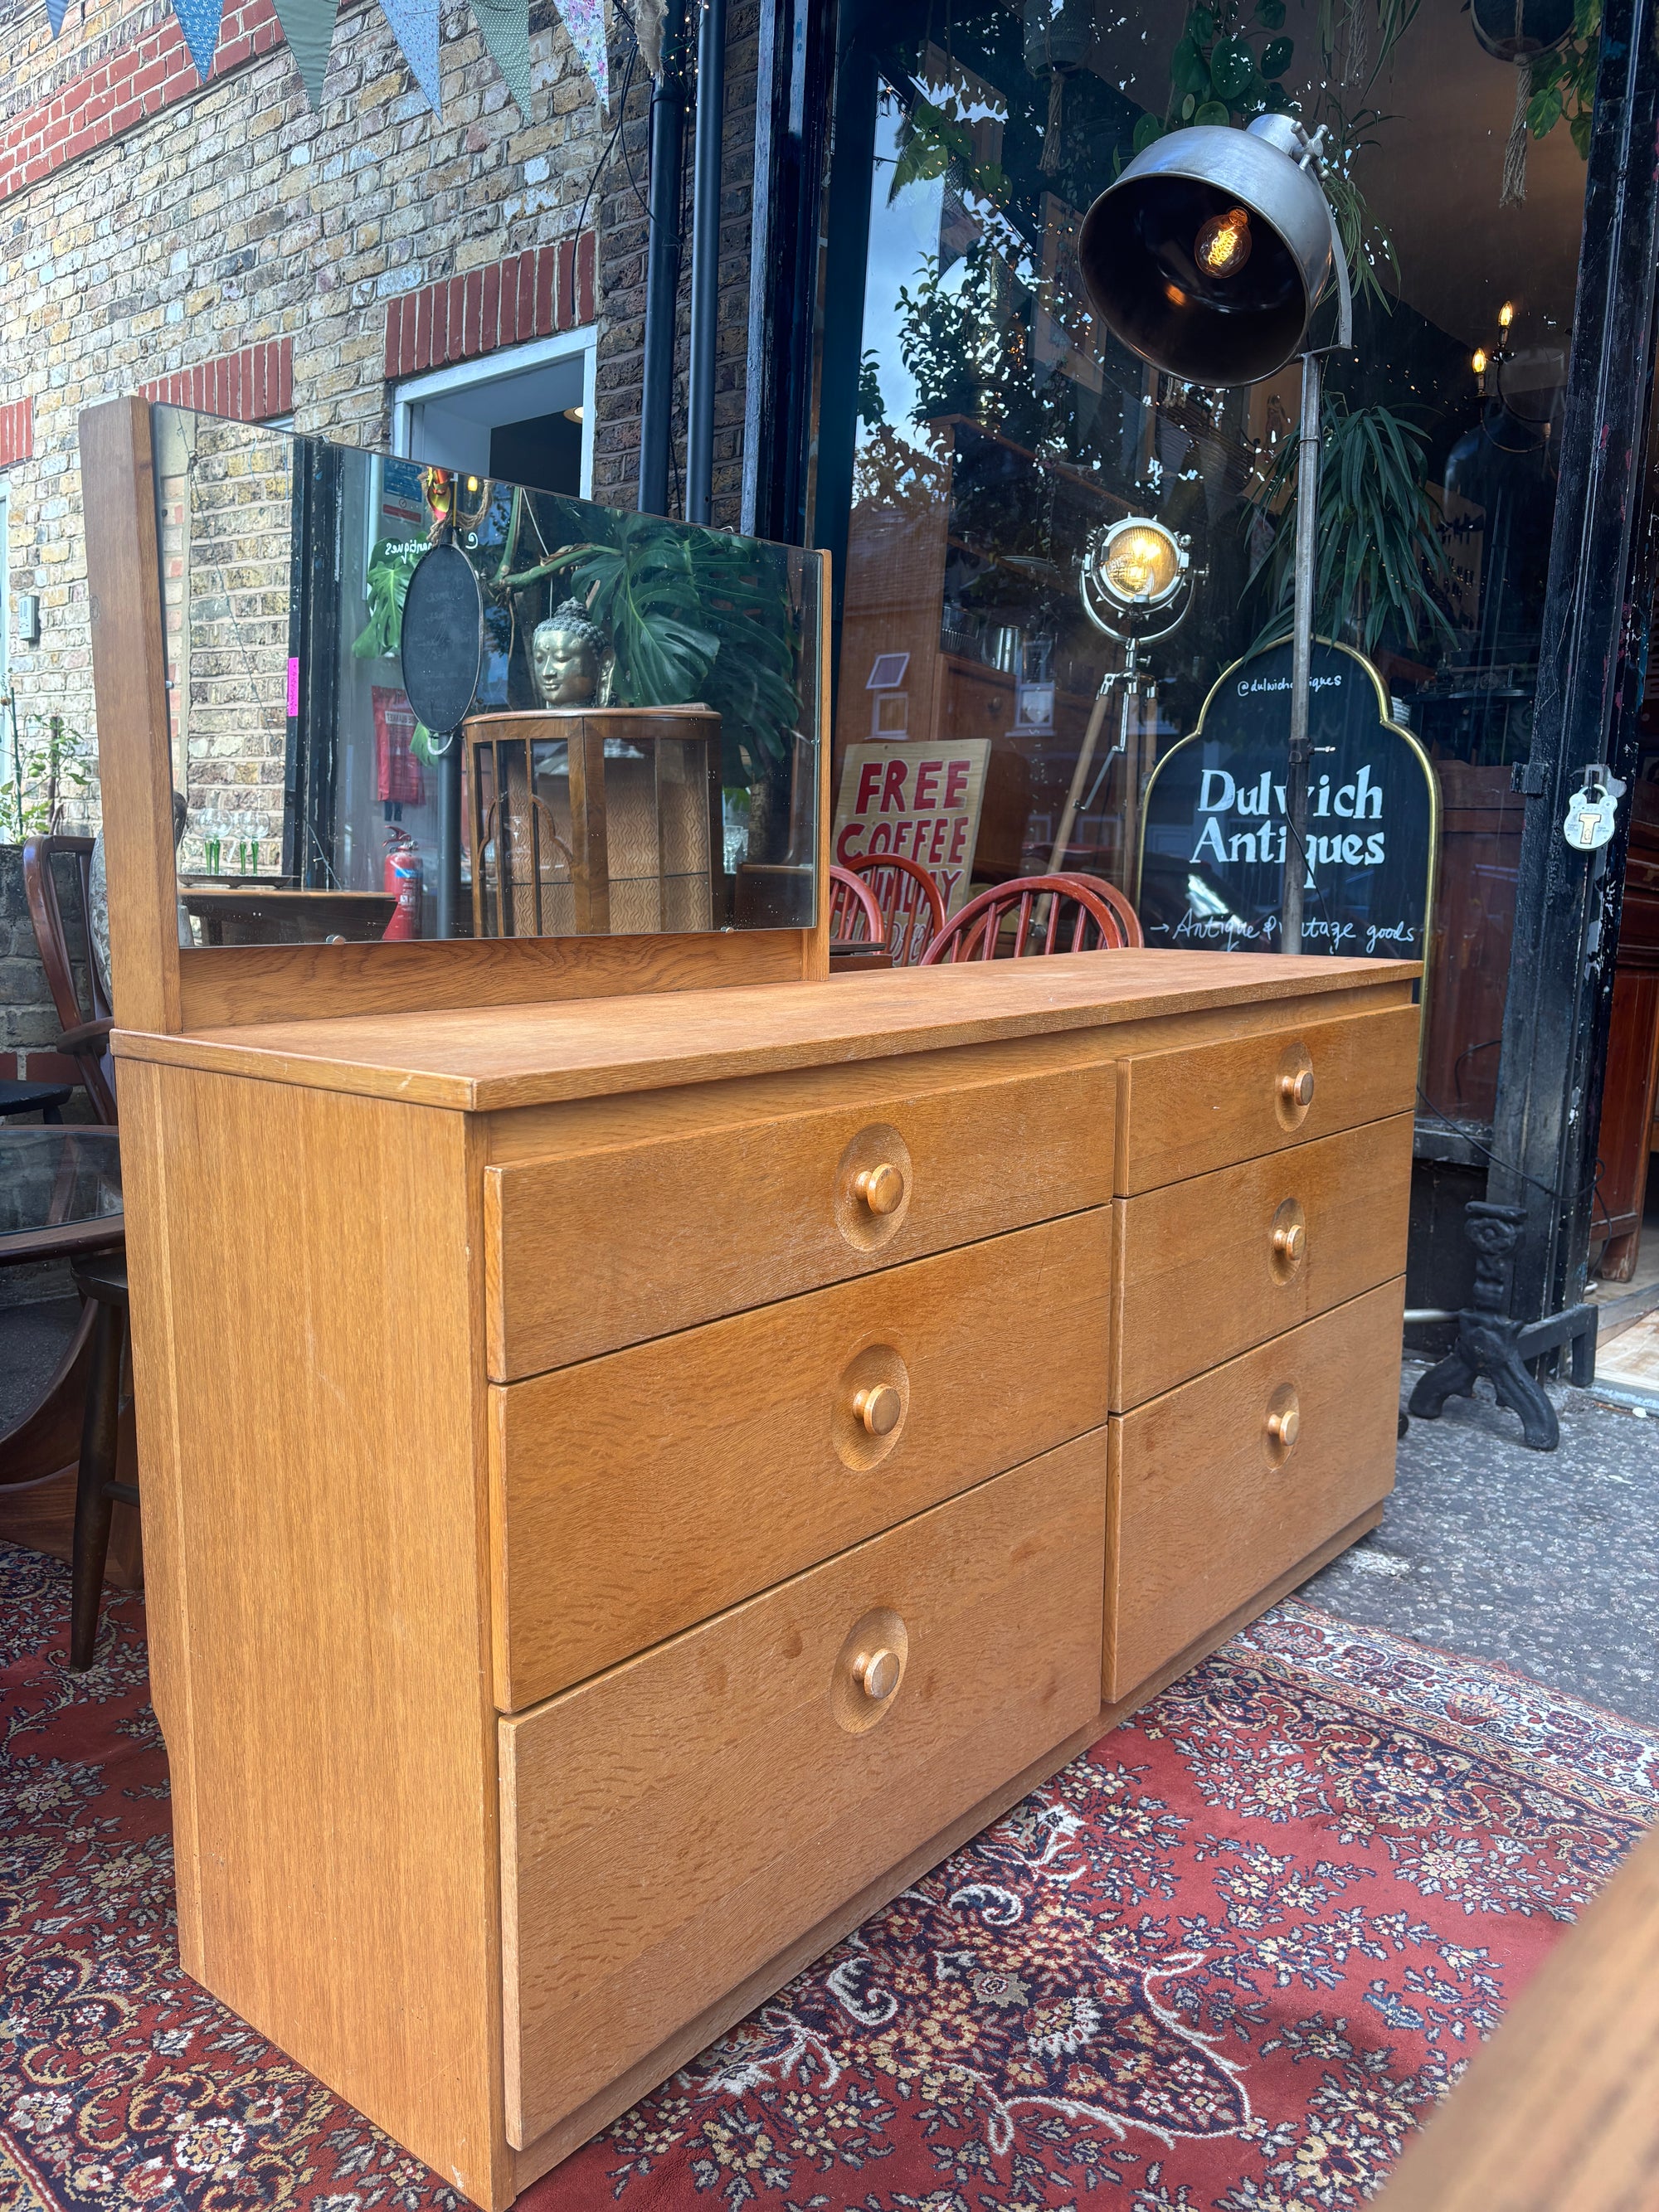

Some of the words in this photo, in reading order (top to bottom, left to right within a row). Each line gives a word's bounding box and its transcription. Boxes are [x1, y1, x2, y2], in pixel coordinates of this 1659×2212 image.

[1237, 674, 1342, 697] @dulwichiques
[854, 759, 971, 816] FREE
[835, 816, 969, 866] COFFEE
[1189, 816, 1385, 889] Antiques
[1171, 907, 1260, 952] Antique
[1278, 916, 1357, 955] tage
[1365, 921, 1415, 954] goods
